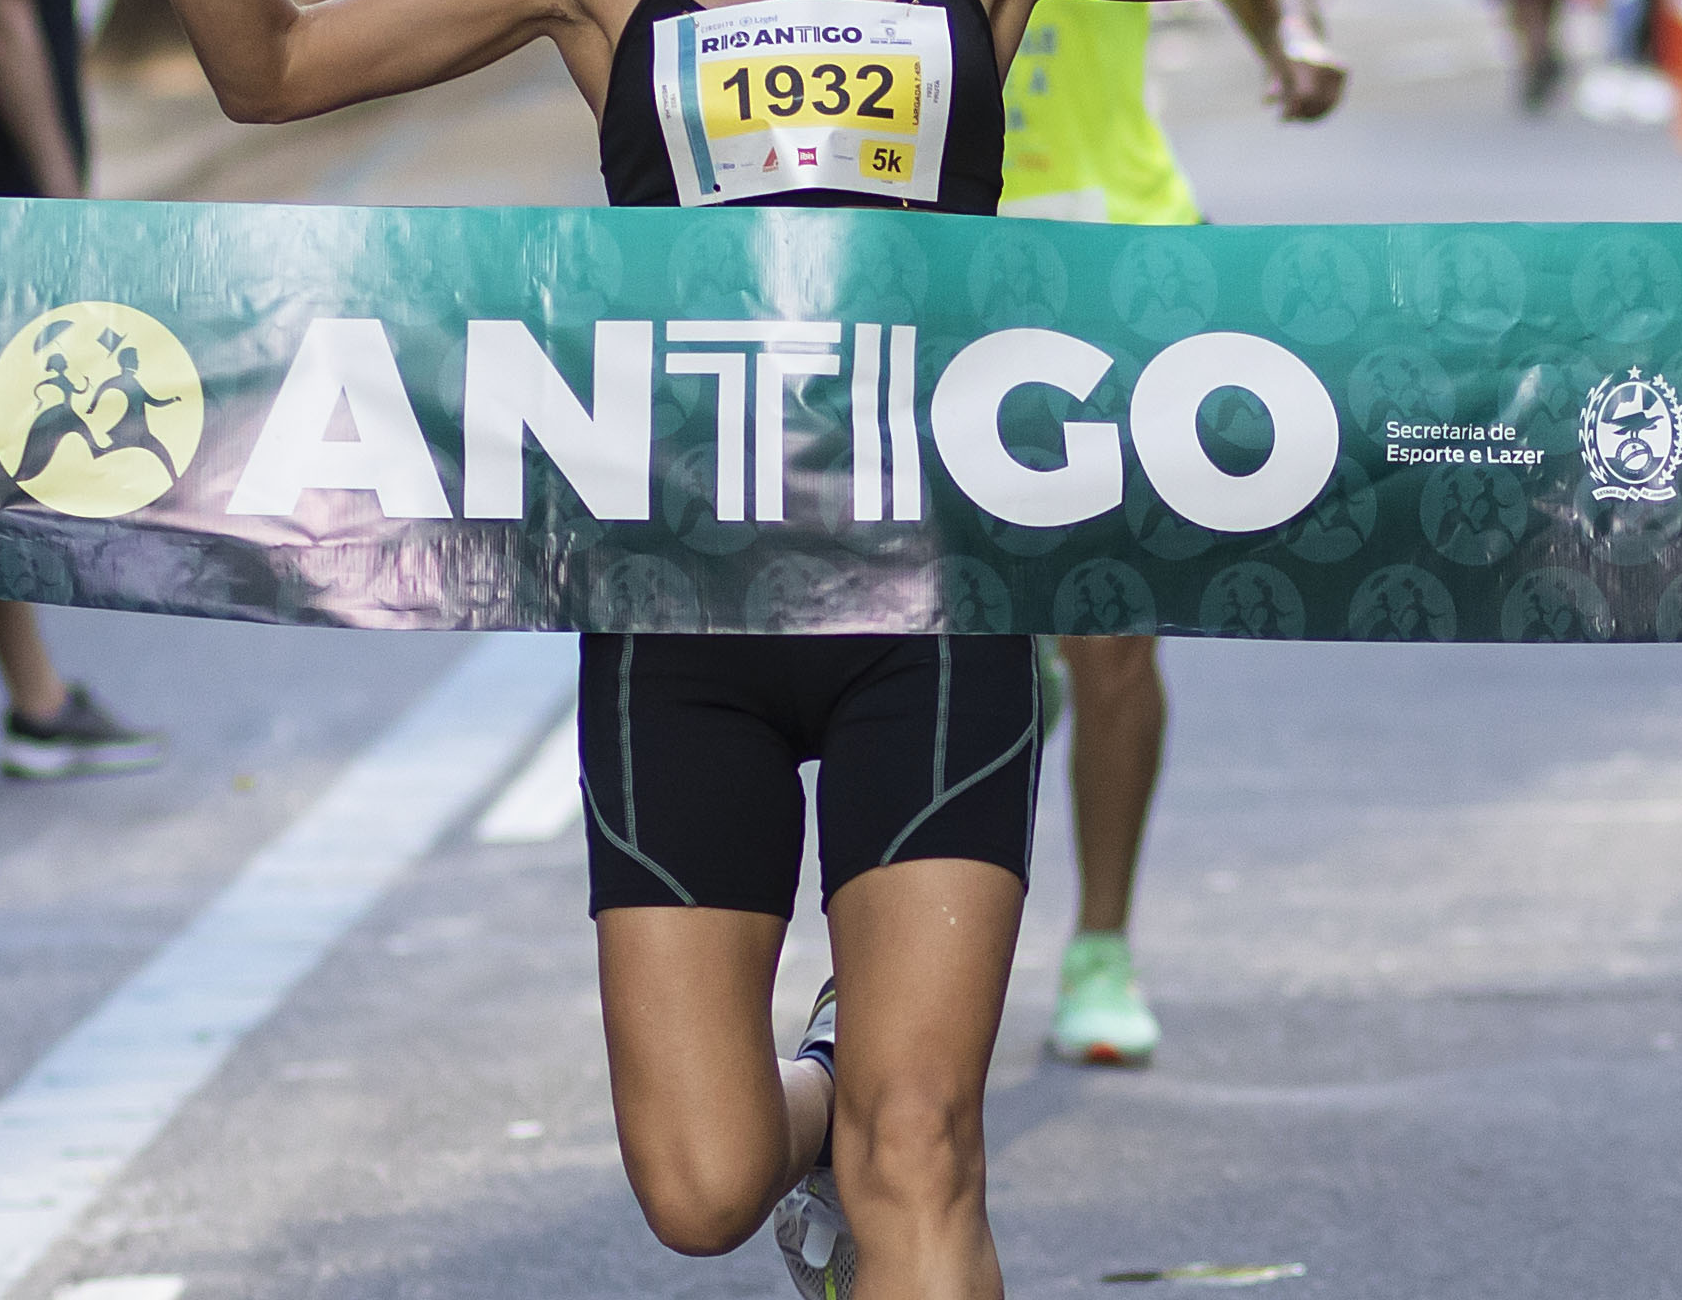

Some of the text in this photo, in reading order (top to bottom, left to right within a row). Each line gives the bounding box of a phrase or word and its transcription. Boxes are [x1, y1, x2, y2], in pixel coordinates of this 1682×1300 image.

[701, 26, 863, 54] RIO ANTIGO
[723, 64, 894, 121] 1932
[872, 147, 902, 173] 5k
[225, 316, 1340, 533] ANTIGO
[1386, 421, 1516, 441] Secretaria de
[1386, 444, 1545, 465] Esporte e Lazer
